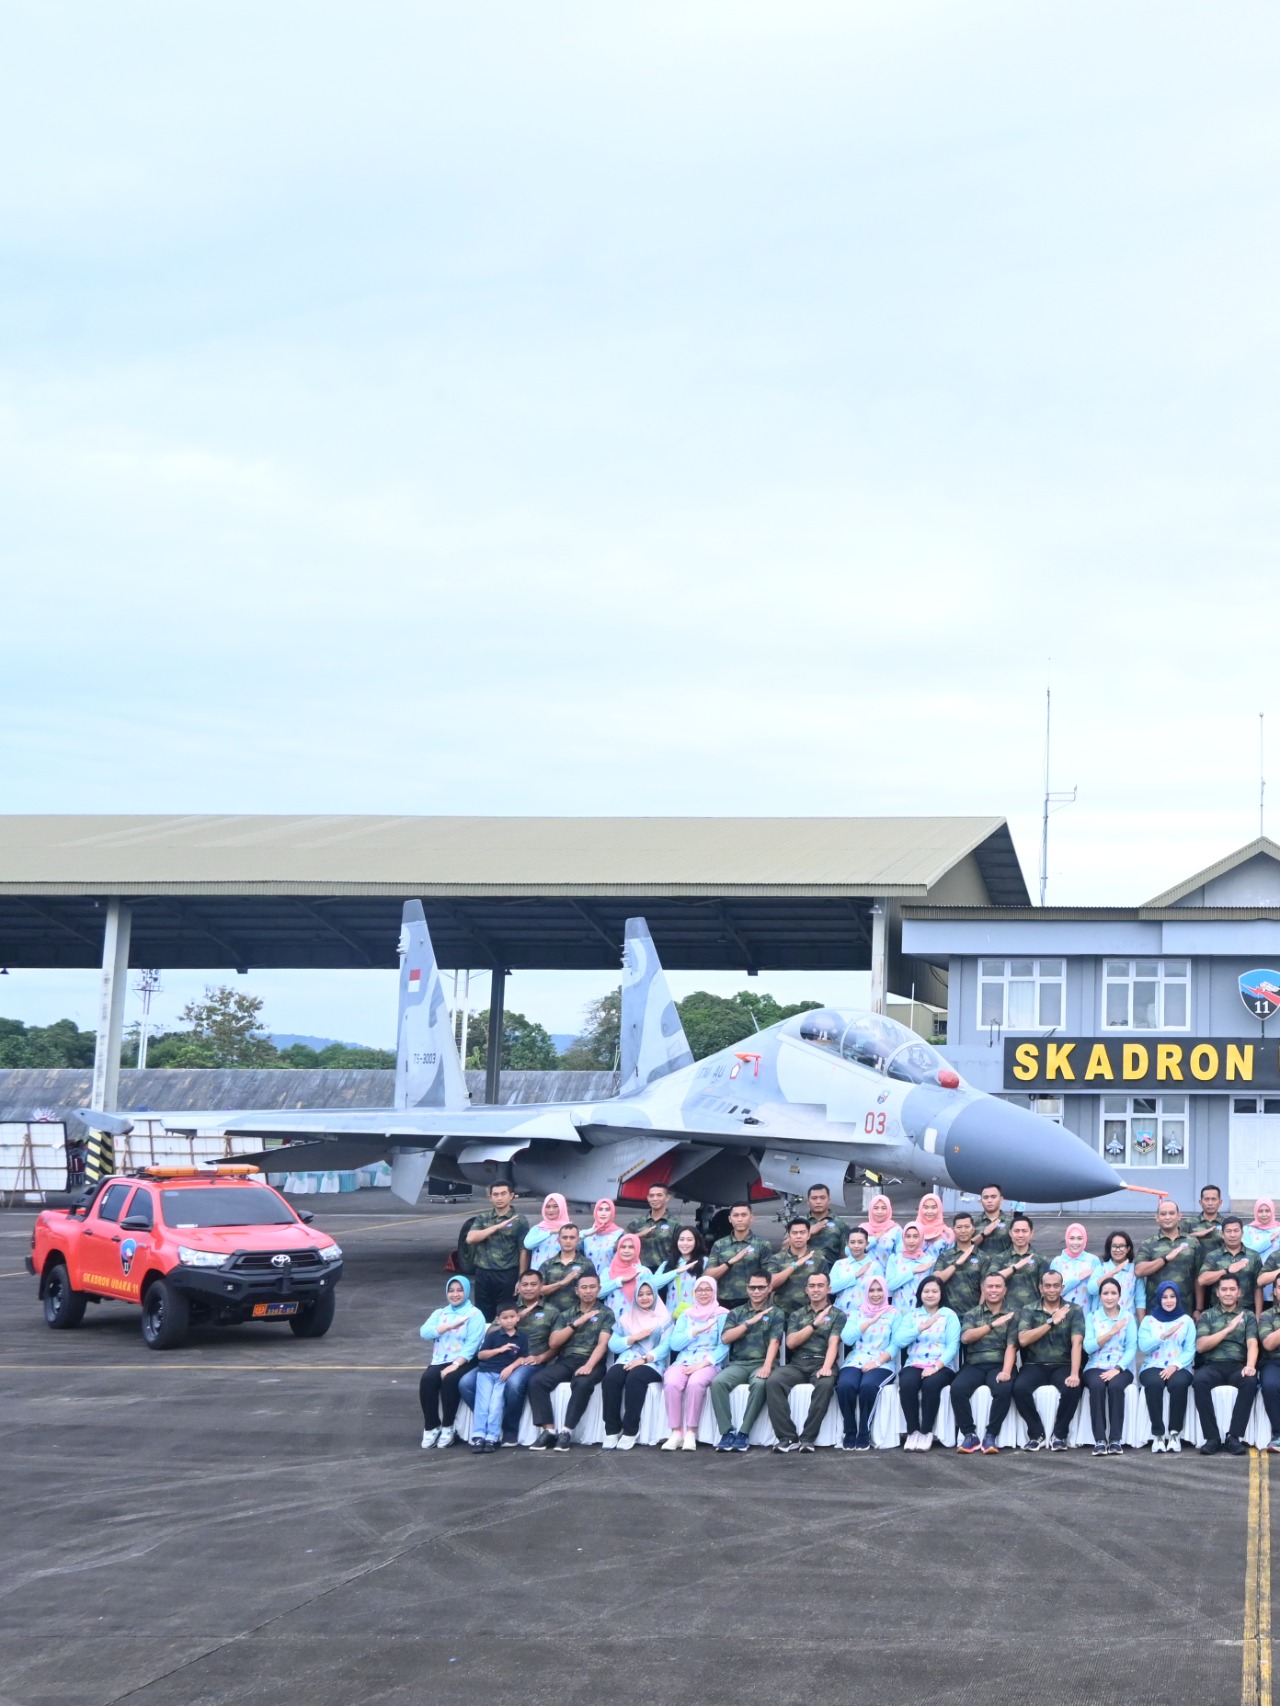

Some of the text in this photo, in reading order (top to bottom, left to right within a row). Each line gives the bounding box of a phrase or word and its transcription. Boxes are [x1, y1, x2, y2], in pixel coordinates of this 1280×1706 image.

[1254, 1000, 1270, 1014] 11
[413, 1053, 436, 1065] TS-3003
[1013, 1043, 1254, 1081] SKADRON
[864, 1111, 887, 1135] 03
[132, 1283, 139, 1294] 11
